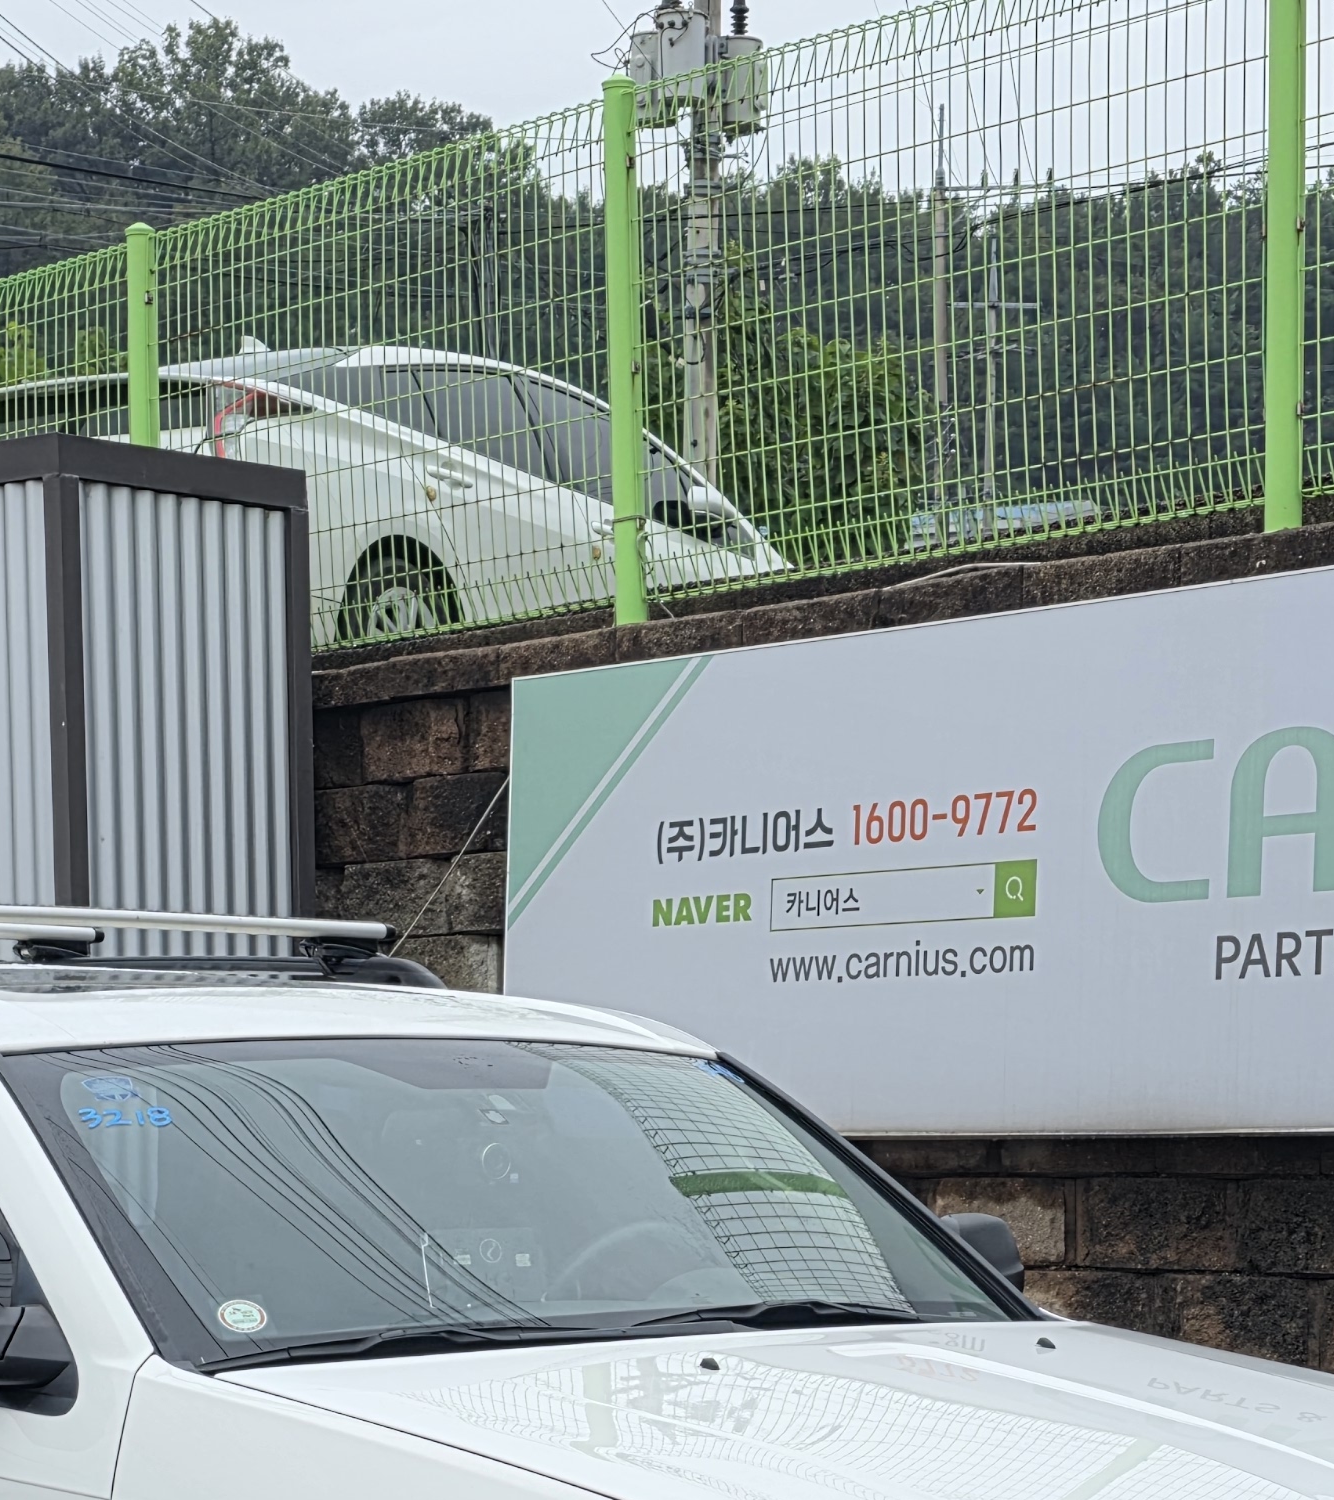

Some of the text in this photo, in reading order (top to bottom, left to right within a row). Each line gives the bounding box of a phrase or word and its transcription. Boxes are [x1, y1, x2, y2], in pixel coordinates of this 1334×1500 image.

[656, 788, 1038, 865] (주)카니어스 1600-9772
[652, 892, 752, 928] NAVER
[785, 887, 861, 918] 카니어스
[769, 939, 1035, 984] www.carnius.com
[77, 1106, 173, 1129] 3218
